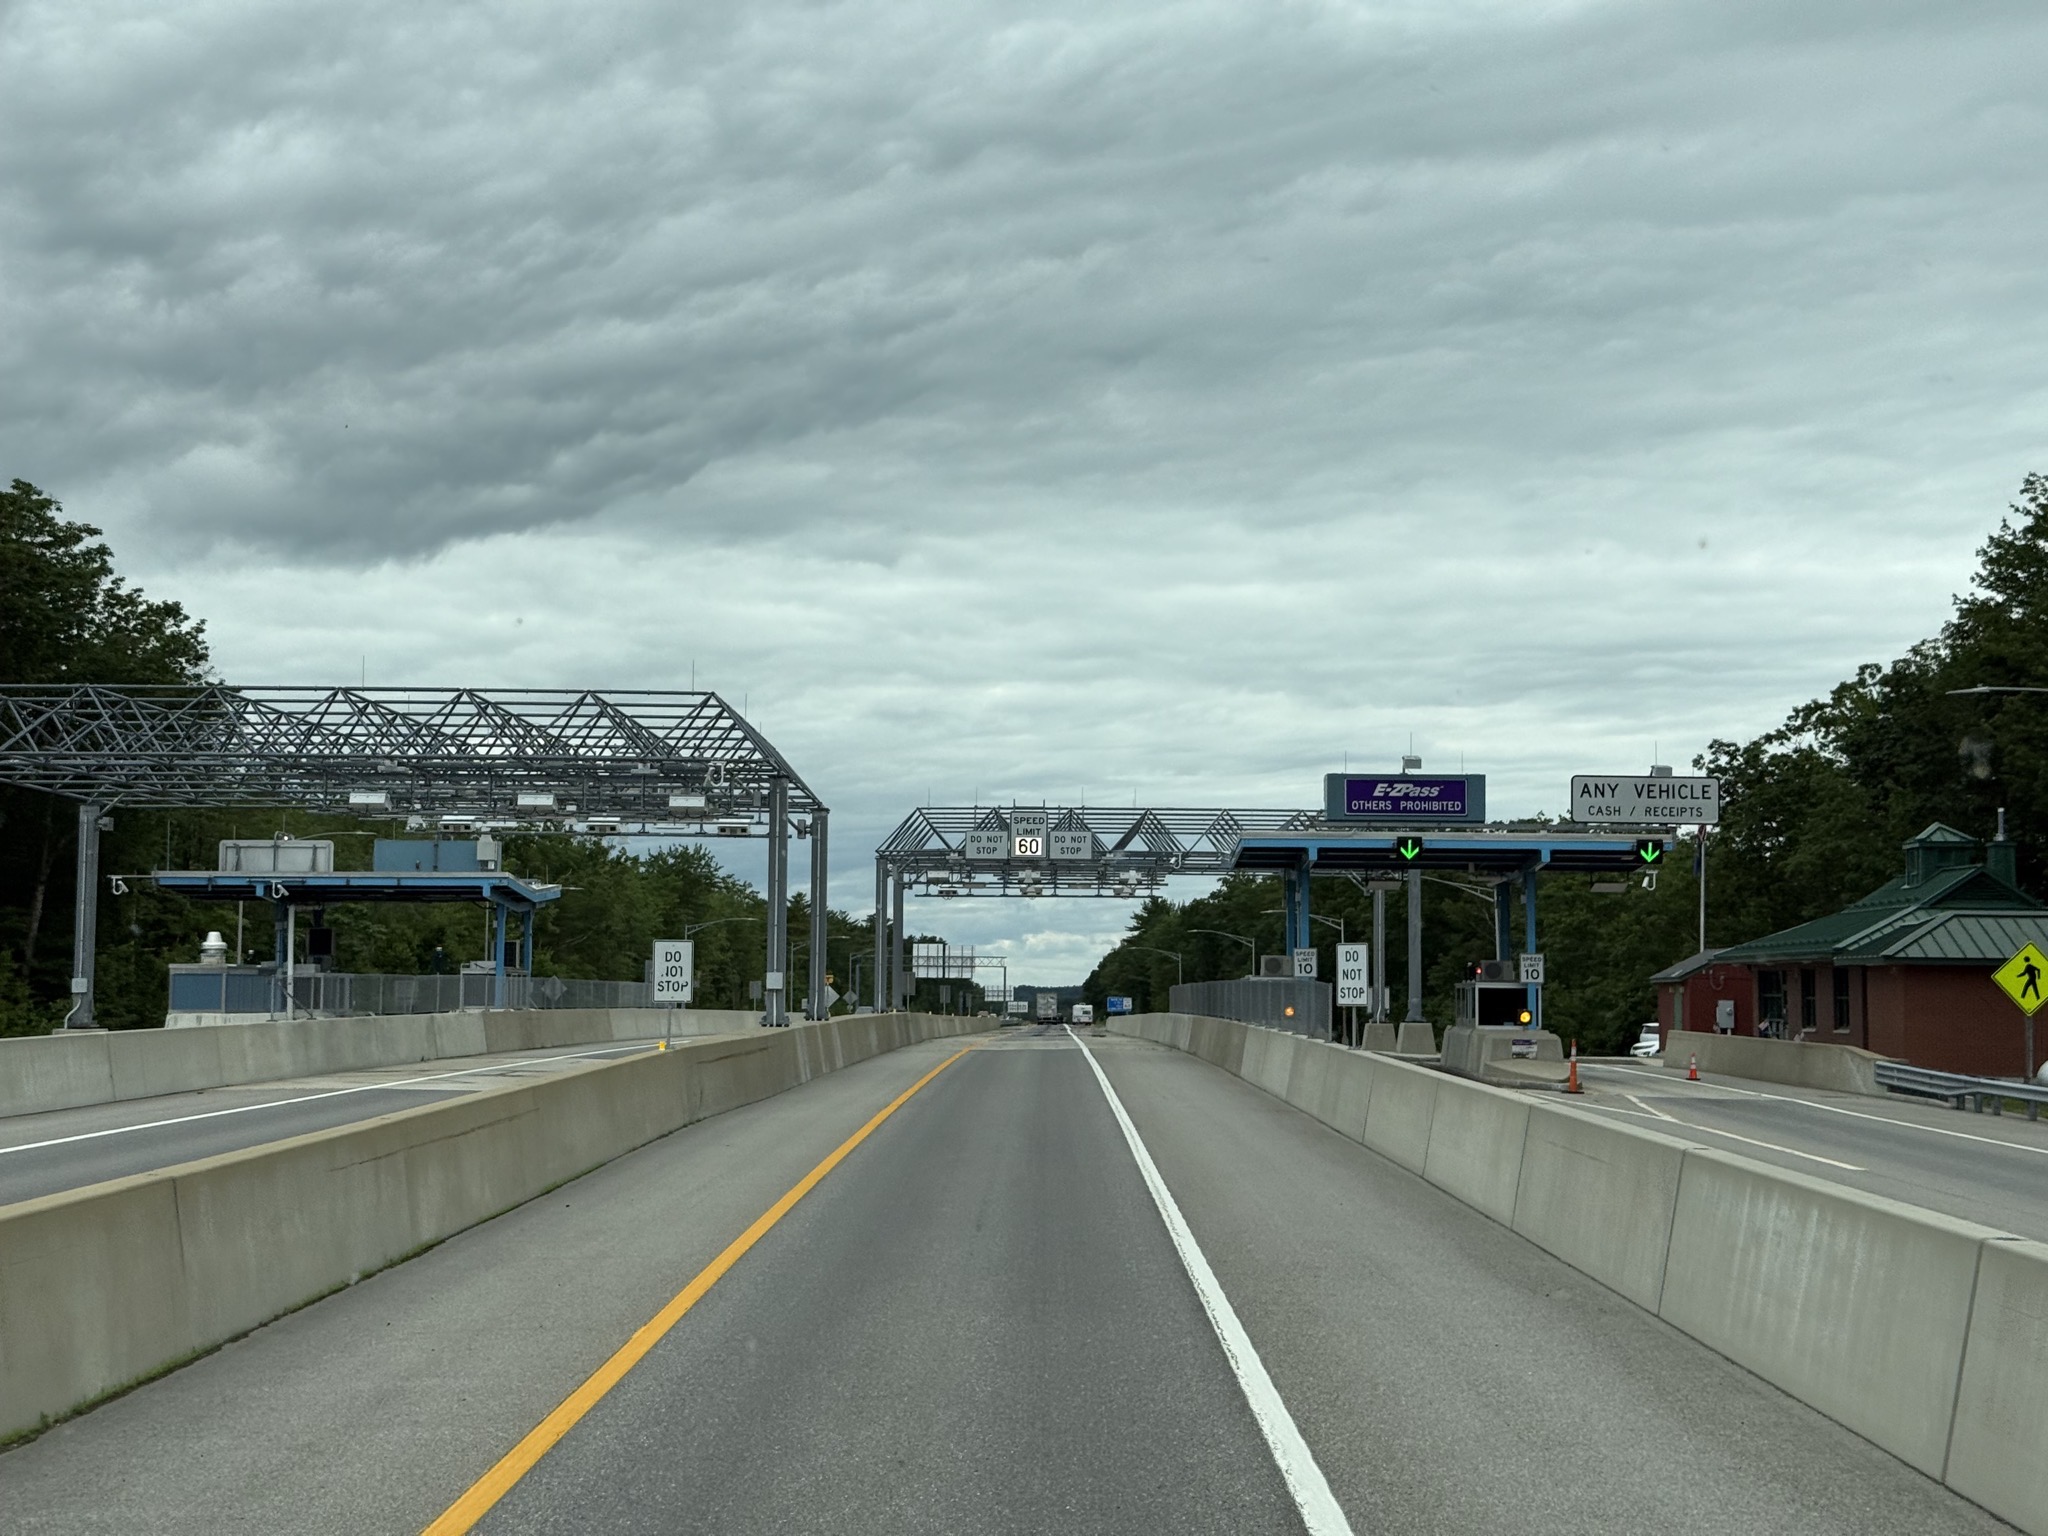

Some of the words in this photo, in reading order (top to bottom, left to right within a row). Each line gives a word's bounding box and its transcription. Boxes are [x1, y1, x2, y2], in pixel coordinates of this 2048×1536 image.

[1373, 783, 1440, 797] E-ZPass
[1580, 783, 1619, 798] ANY
[1634, 784, 1712, 800] VEHICLE
[1351, 800, 1392, 811] OTHERS
[1400, 801, 1462, 811] PROHIBITED
[1588, 805, 1621, 816] CASH
[1629, 806, 1636, 817] /
[1644, 806, 1703, 817] RECEIPTS
[1013, 816, 1045, 825] SPEED
[1016, 828, 1041, 836] LIMIT
[970, 835, 982, 843] DO
[986, 835, 1004, 843] NOT
[1054, 835, 1066, 843] DO
[1070, 835, 1087, 843] NOT
[976, 846, 998, 855] STOP
[1019, 838, 1039, 854] 60
[1060, 846, 1082, 855] STOP
[664, 950, 682, 962] DO
[1345, 950, 1359, 962] DO
[1298, 963, 1313, 974] 10
[1342, 968, 1363, 981] NOT
[1524, 968, 1540, 980] 10
[657, 980, 689, 992] STOP
[1340, 987, 1365, 999] STOP
